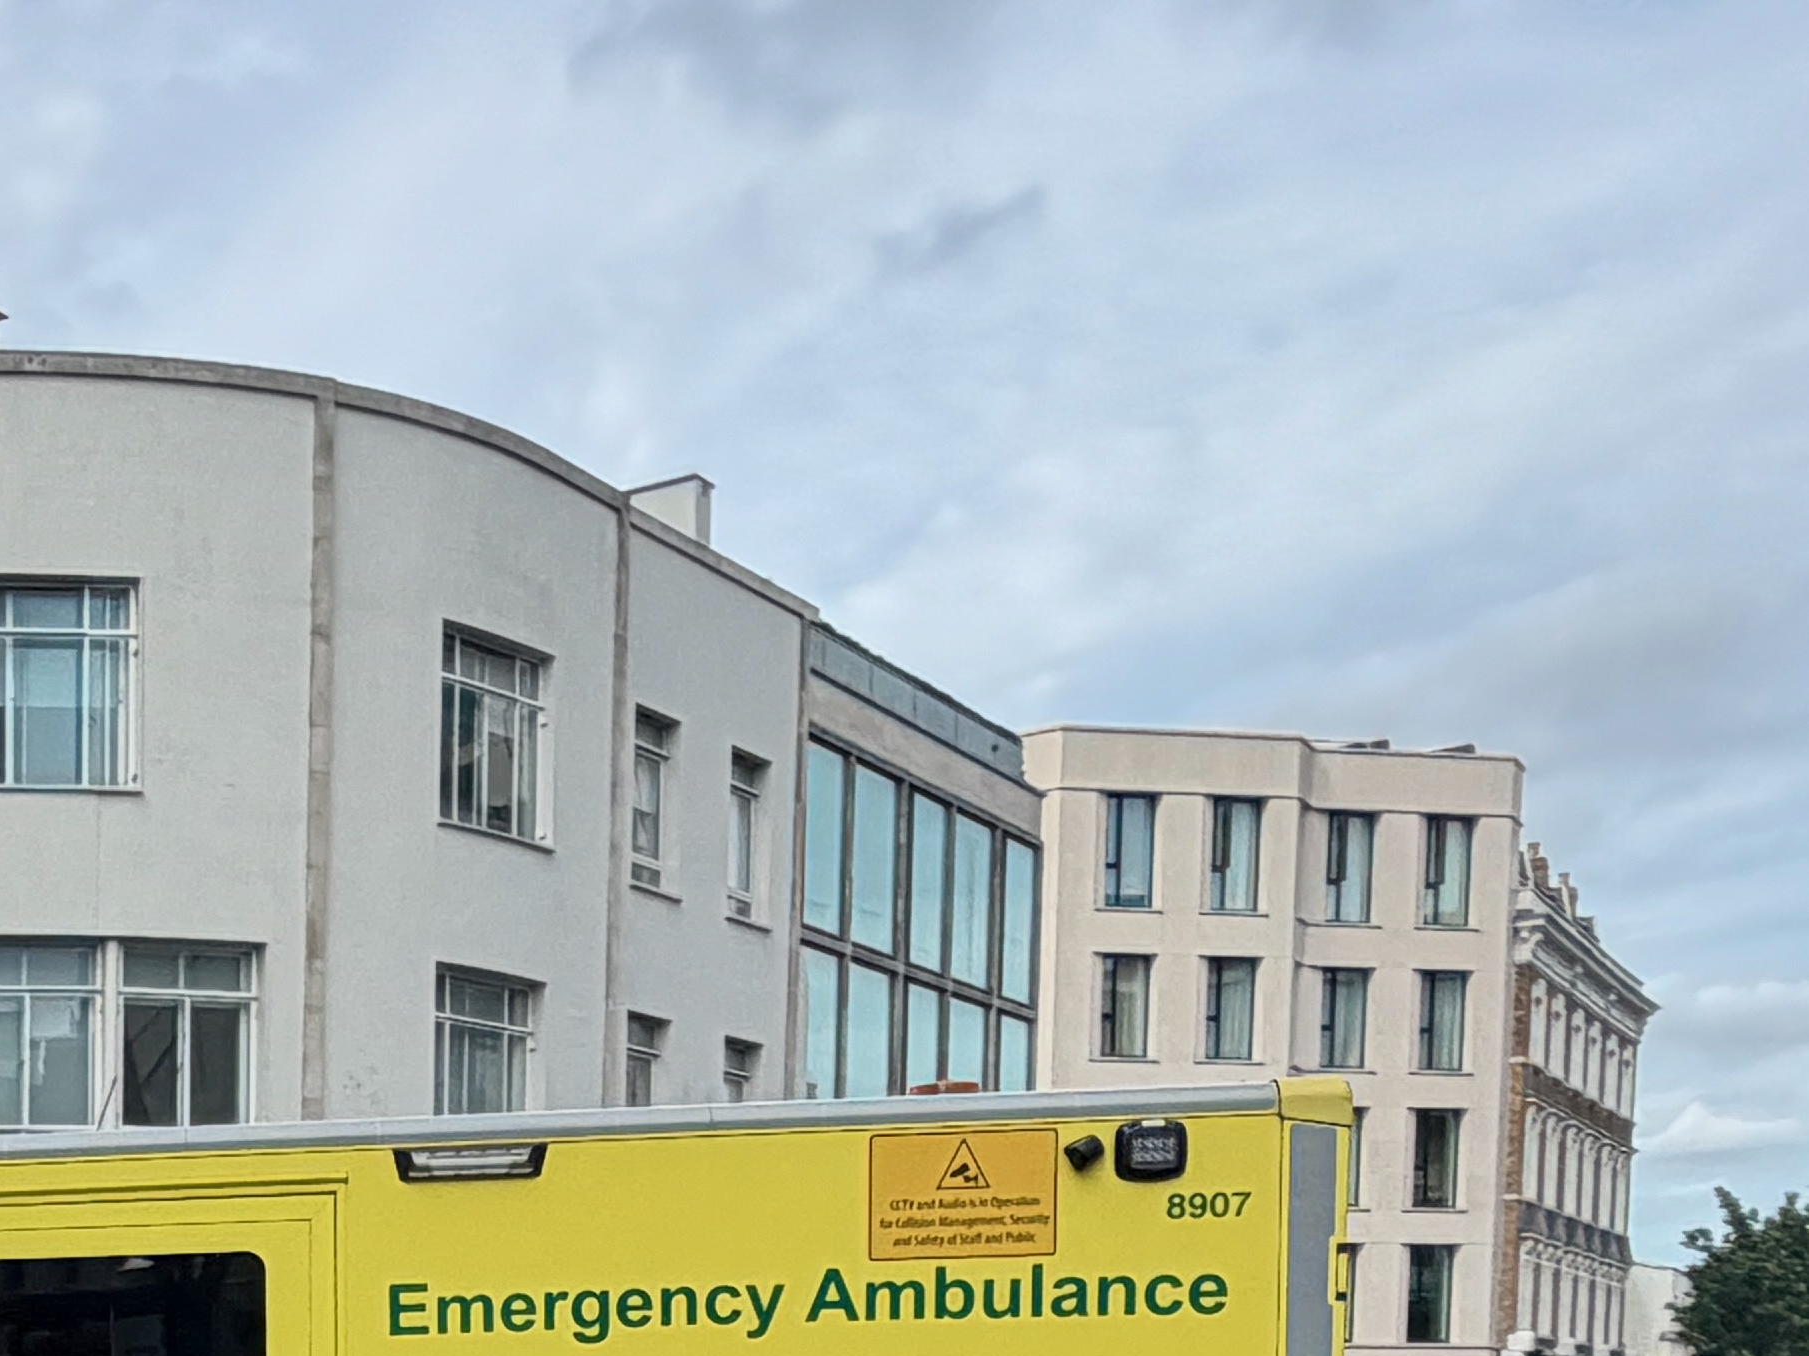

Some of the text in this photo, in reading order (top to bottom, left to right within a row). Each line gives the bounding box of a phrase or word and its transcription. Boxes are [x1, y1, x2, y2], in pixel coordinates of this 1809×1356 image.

[917, 1199, 935, 1210] and
[1166, 1192, 1251, 1219] 8907
[893, 1236, 912, 1246] and
[914, 1235, 944, 1247] Safety
[959, 1233, 982, 1244] Staff
[984, 1233, 1003, 1244] and
[389, 1265, 1228, 1344] Emergency Ambulance
